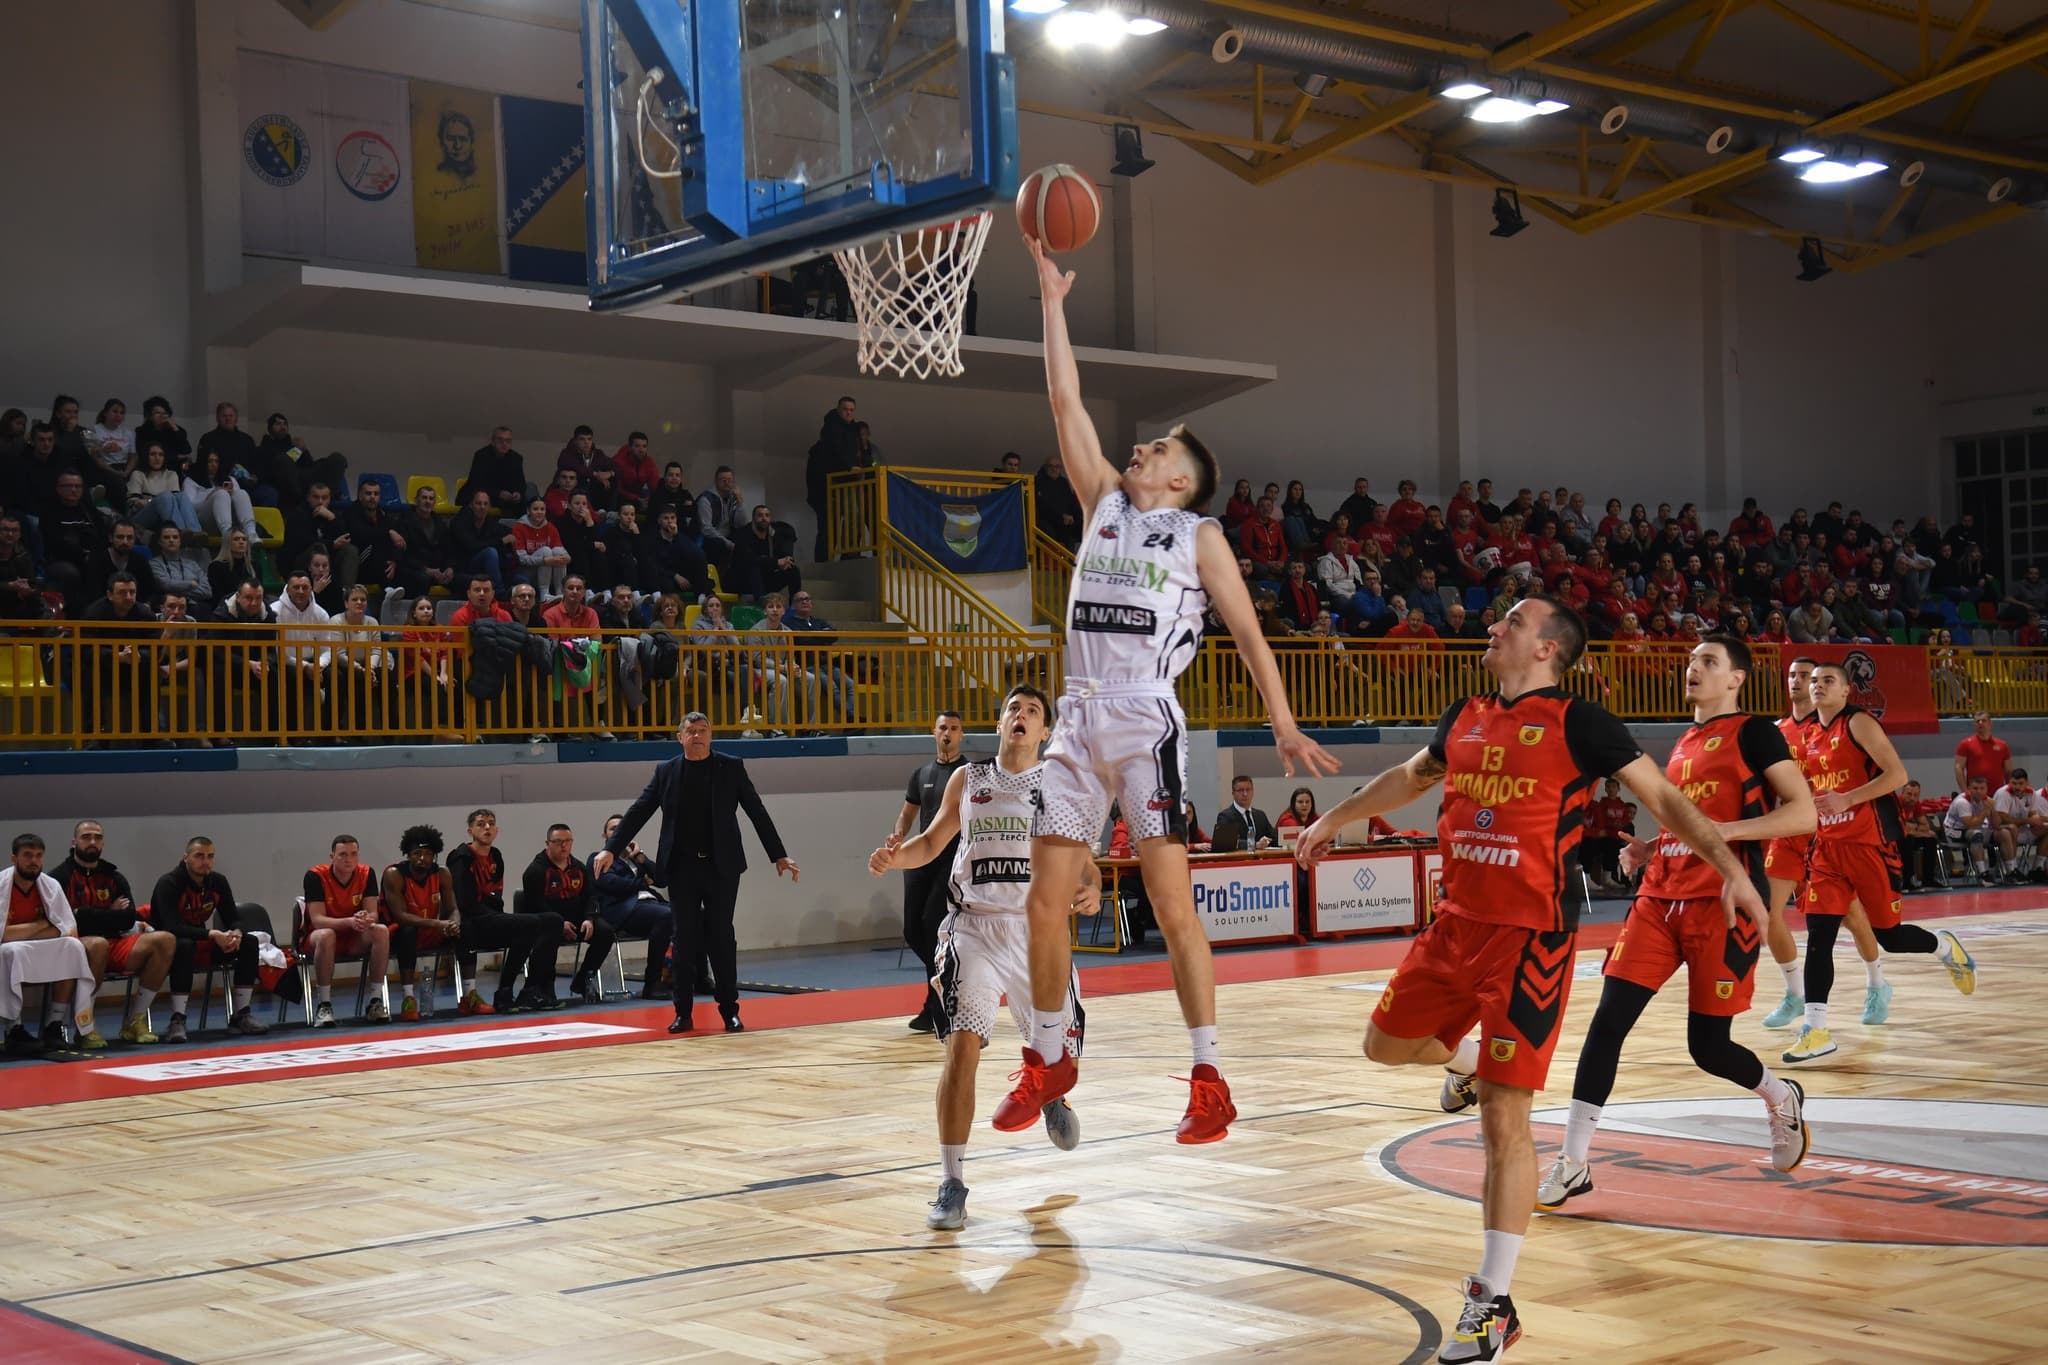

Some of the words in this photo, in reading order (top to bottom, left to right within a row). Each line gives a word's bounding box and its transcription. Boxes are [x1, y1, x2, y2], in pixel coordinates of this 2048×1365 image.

[1142, 533, 1174, 551] 24
[1106, 576, 1137, 587] ŽEPČE
[1481, 745, 1506, 771] 13
[1682, 759, 1693, 780] 11
[1000, 834, 1027, 842] ŽEPČE
[1193, 880, 1290, 914] ProSmart
[1317, 900, 1339, 912] Nansi
[1340, 899, 1356, 910] PVC
[1357, 898, 1364, 908] &
[1365, 897, 1380, 908] ALU
[1381, 896, 1411, 908] Systems
[1214, 914, 1269, 926] SOLUTIONS
[1609, 941, 1625, 961] 11
[1946, 1178, 2048, 1198] ICH
